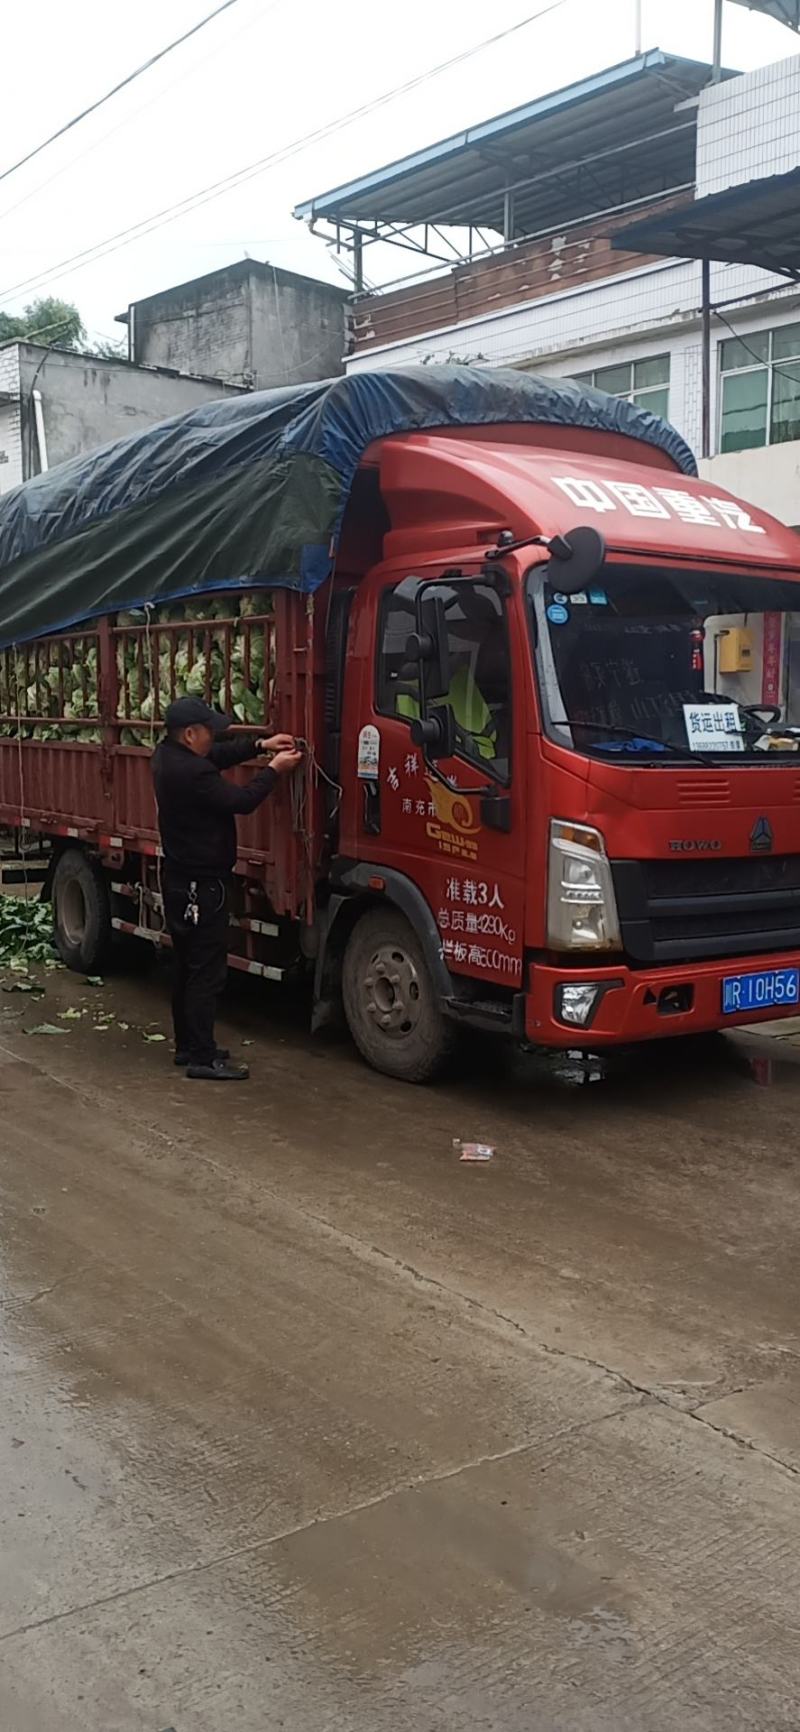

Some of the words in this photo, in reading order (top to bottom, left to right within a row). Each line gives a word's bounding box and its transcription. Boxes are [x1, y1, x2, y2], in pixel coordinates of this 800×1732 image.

[550, 476, 766, 534] 中国重汽
[689, 711, 737, 734] 货运出租
[668, 839, 722, 851] HOWO
[445, 876, 505, 910] 准载3人
